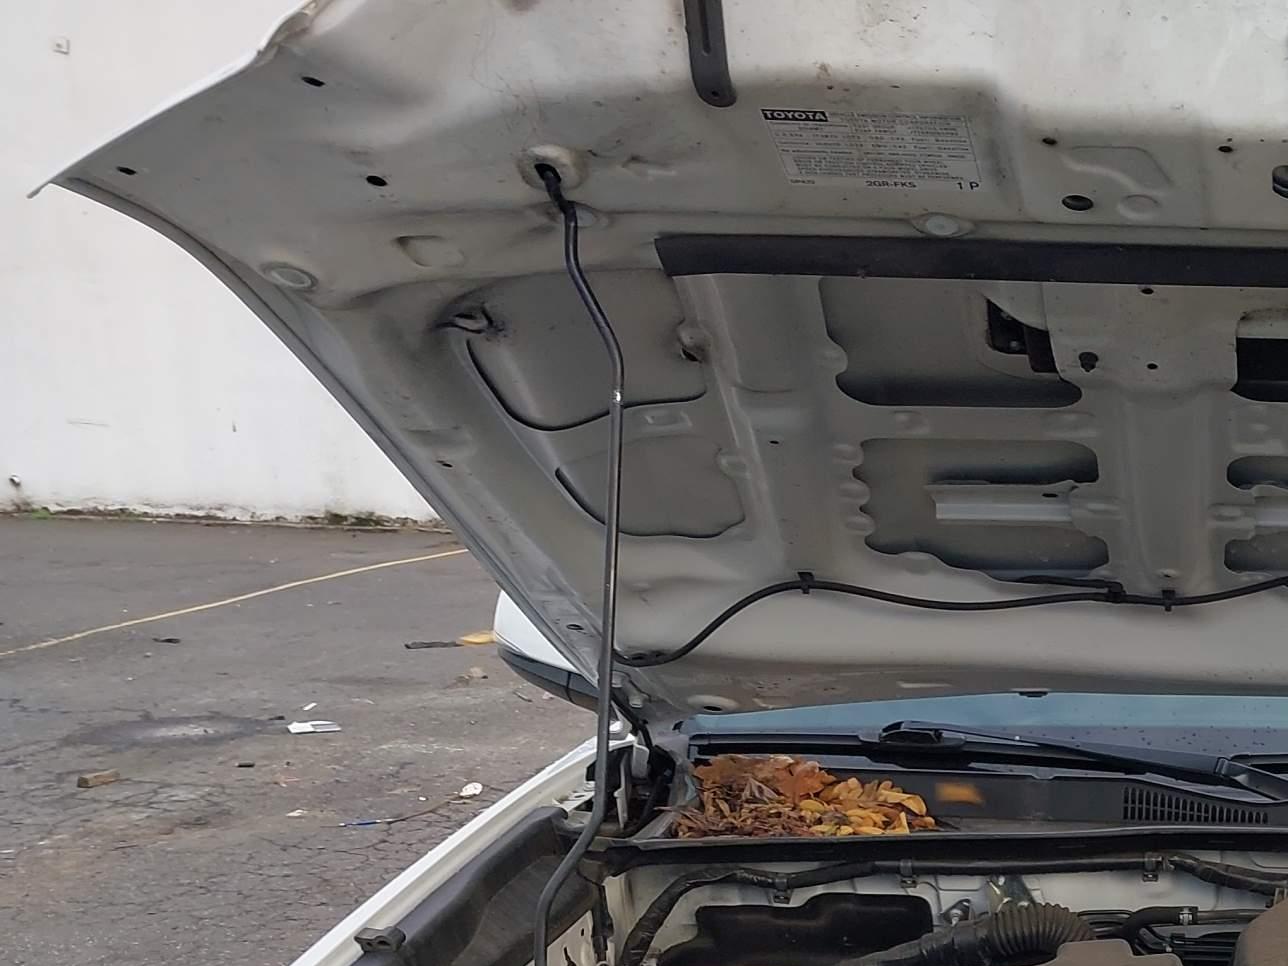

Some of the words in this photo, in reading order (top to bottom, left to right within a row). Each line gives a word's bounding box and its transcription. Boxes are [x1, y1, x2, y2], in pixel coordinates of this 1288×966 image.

[763, 110, 827, 121] TOYOTA
[865, 180, 916, 188] 2GR-FKS
[969, 182, 979, 190] P
